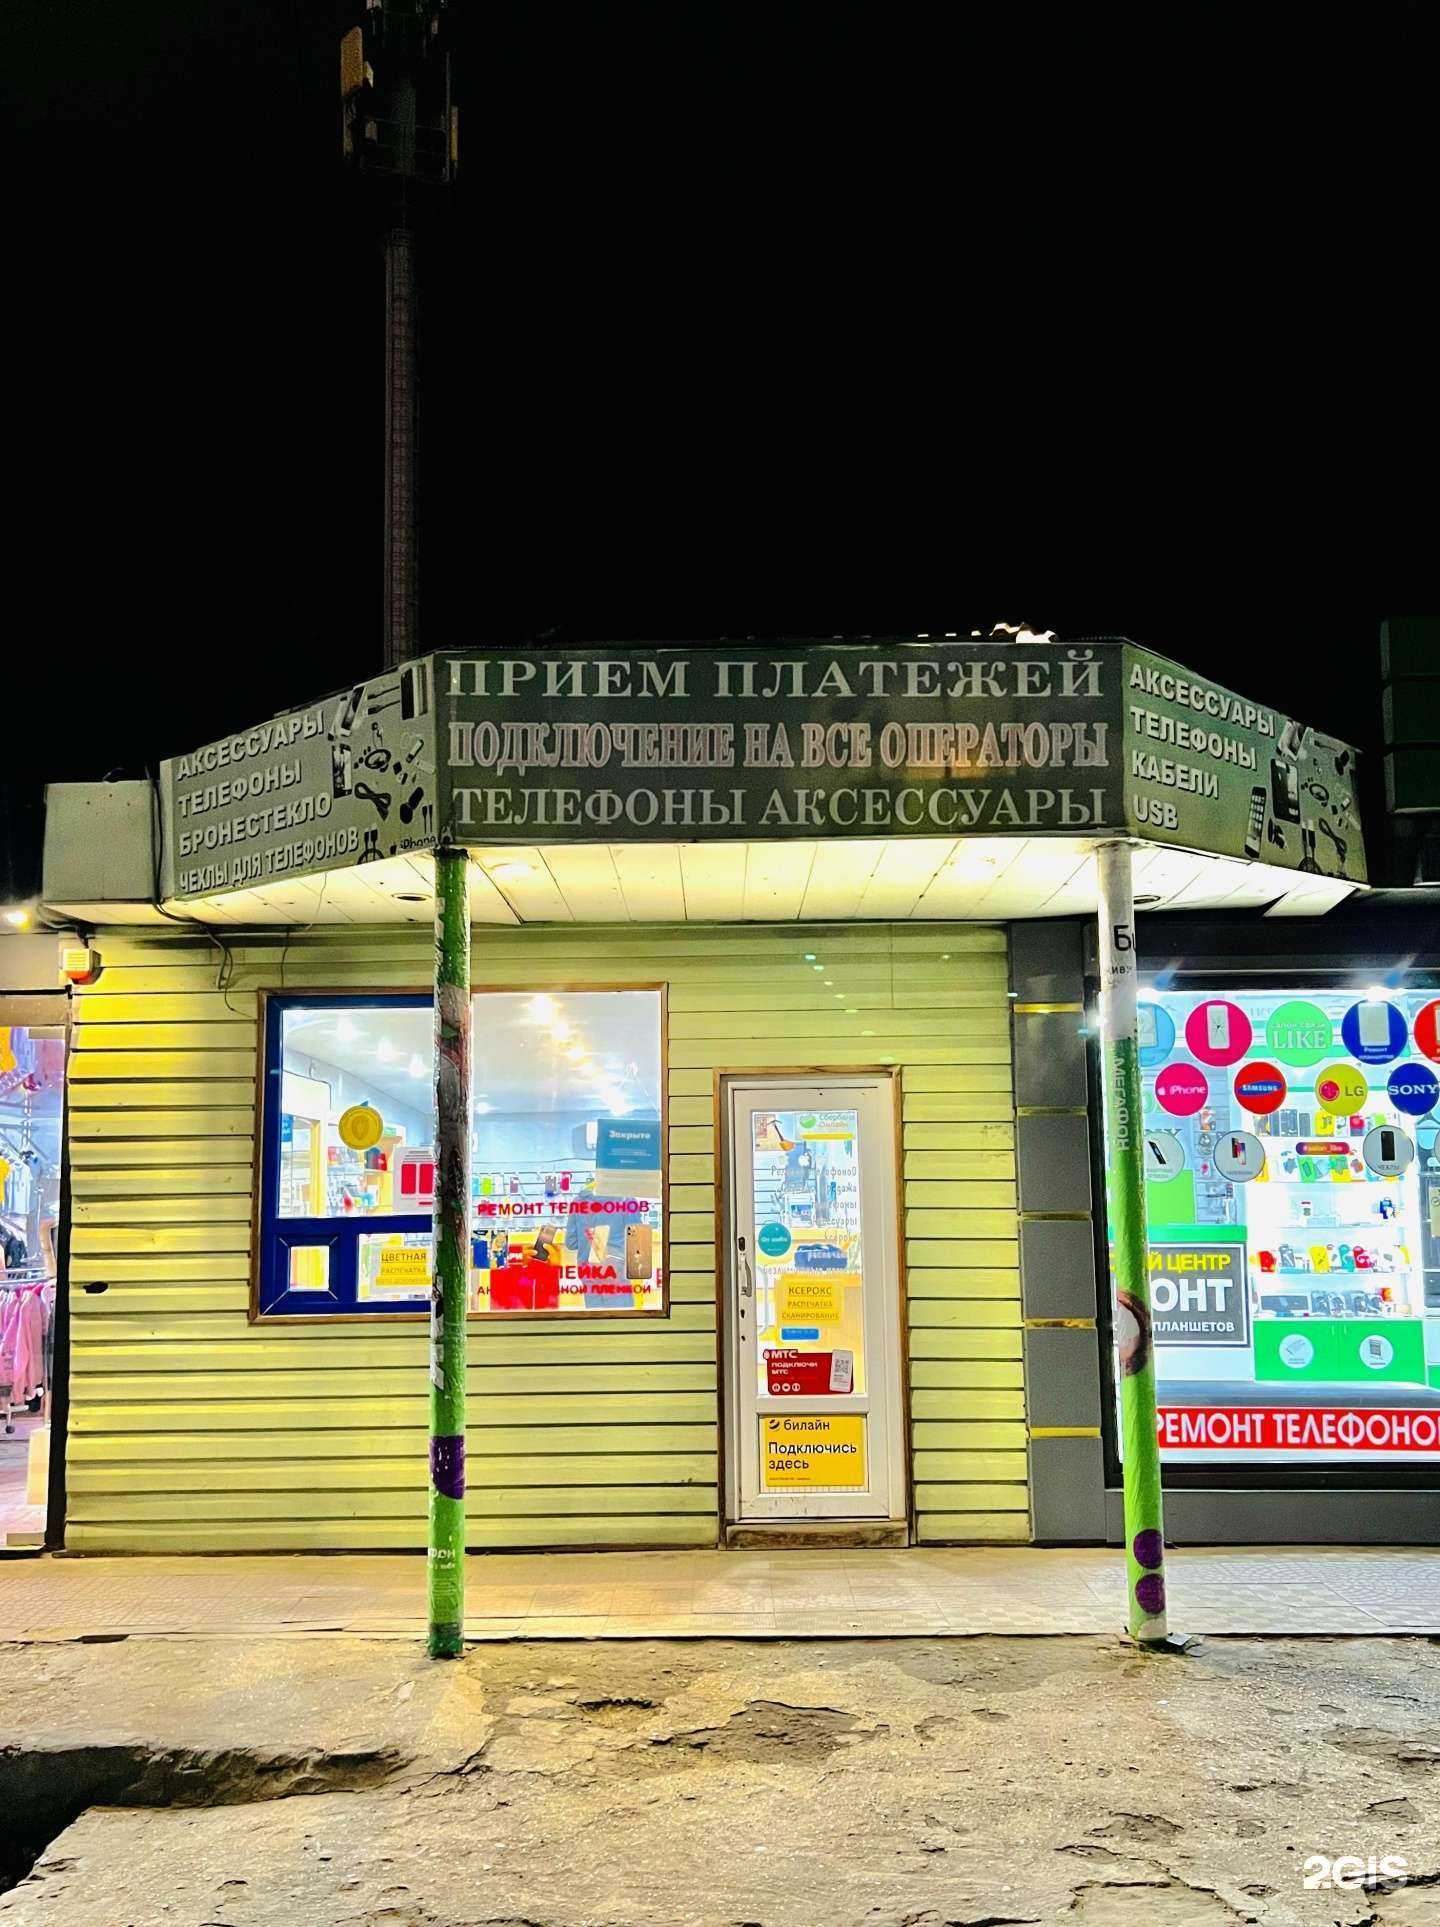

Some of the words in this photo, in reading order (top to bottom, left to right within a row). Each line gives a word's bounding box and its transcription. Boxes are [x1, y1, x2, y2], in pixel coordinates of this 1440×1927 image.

[446, 660, 690, 697] ПРИЕМ
[714, 649, 1104, 698] ПЛАТЕЖЕЙ
[1130, 664, 1275, 737] АКСЕССУАРЫ
[178, 711, 325, 781] АКСЕССУАРЫ
[448, 721, 735, 776] ПОДКЛЮЧЕНИЕ
[743, 721, 795, 767] НА
[801, 722, 872, 767] ВСЕ
[880, 721, 1109, 767] ОПЕРАТОРЫ
[1130, 706, 1256, 771] ТЕЛЕФОНЫ
[1132, 751, 1219, 798] КАБЕЛИ
[178, 760, 302, 817] ТЕЛЕФОНЫ
[452, 787, 747, 826] ТЕЛЕФОНЫ
[758, 788, 1107, 826] АКСЕССУАРЫ
[1133, 795, 1178, 829] USB
[180, 792, 332, 857] БРОНЕСТЕКЛО
[181, 861, 229, 893] ЧЕХЛЫ
[231, 857, 261, 887] ДЛЯ
[266, 827, 358, 874] ТЕЛЕФОНОВ
[1273, 1030, 1327, 1048] LIKE
[1170, 1085, 1206, 1095] iPhone
[1345, 1086, 1364, 1096] LG
[1388, 1085, 1438, 1095] SONY
[478, 1203, 544, 1216] РЕМОНТ
[550, 1200, 649, 1214] ТЕЛЕФОНОВ
[381, 1253, 426, 1263] ЦВЕТНАЯ
[1166, 1253, 1231, 1273] ЦЕНТР
[788, 1286, 832, 1295] КСЕРОКС
[1150, 1278, 1233, 1312] ОНТ
[1153, 1321, 1235, 1332] ПЛАНШЕТОВ
[771, 1351, 798, 1359] МТС
[784, 1419, 830, 1431] билайн
[1272, 1413, 1440, 1446] ТЕЛЕФОНО
[769, 1442, 857, 1455] Подключись
[769, 1460, 809, 1470] здесь
